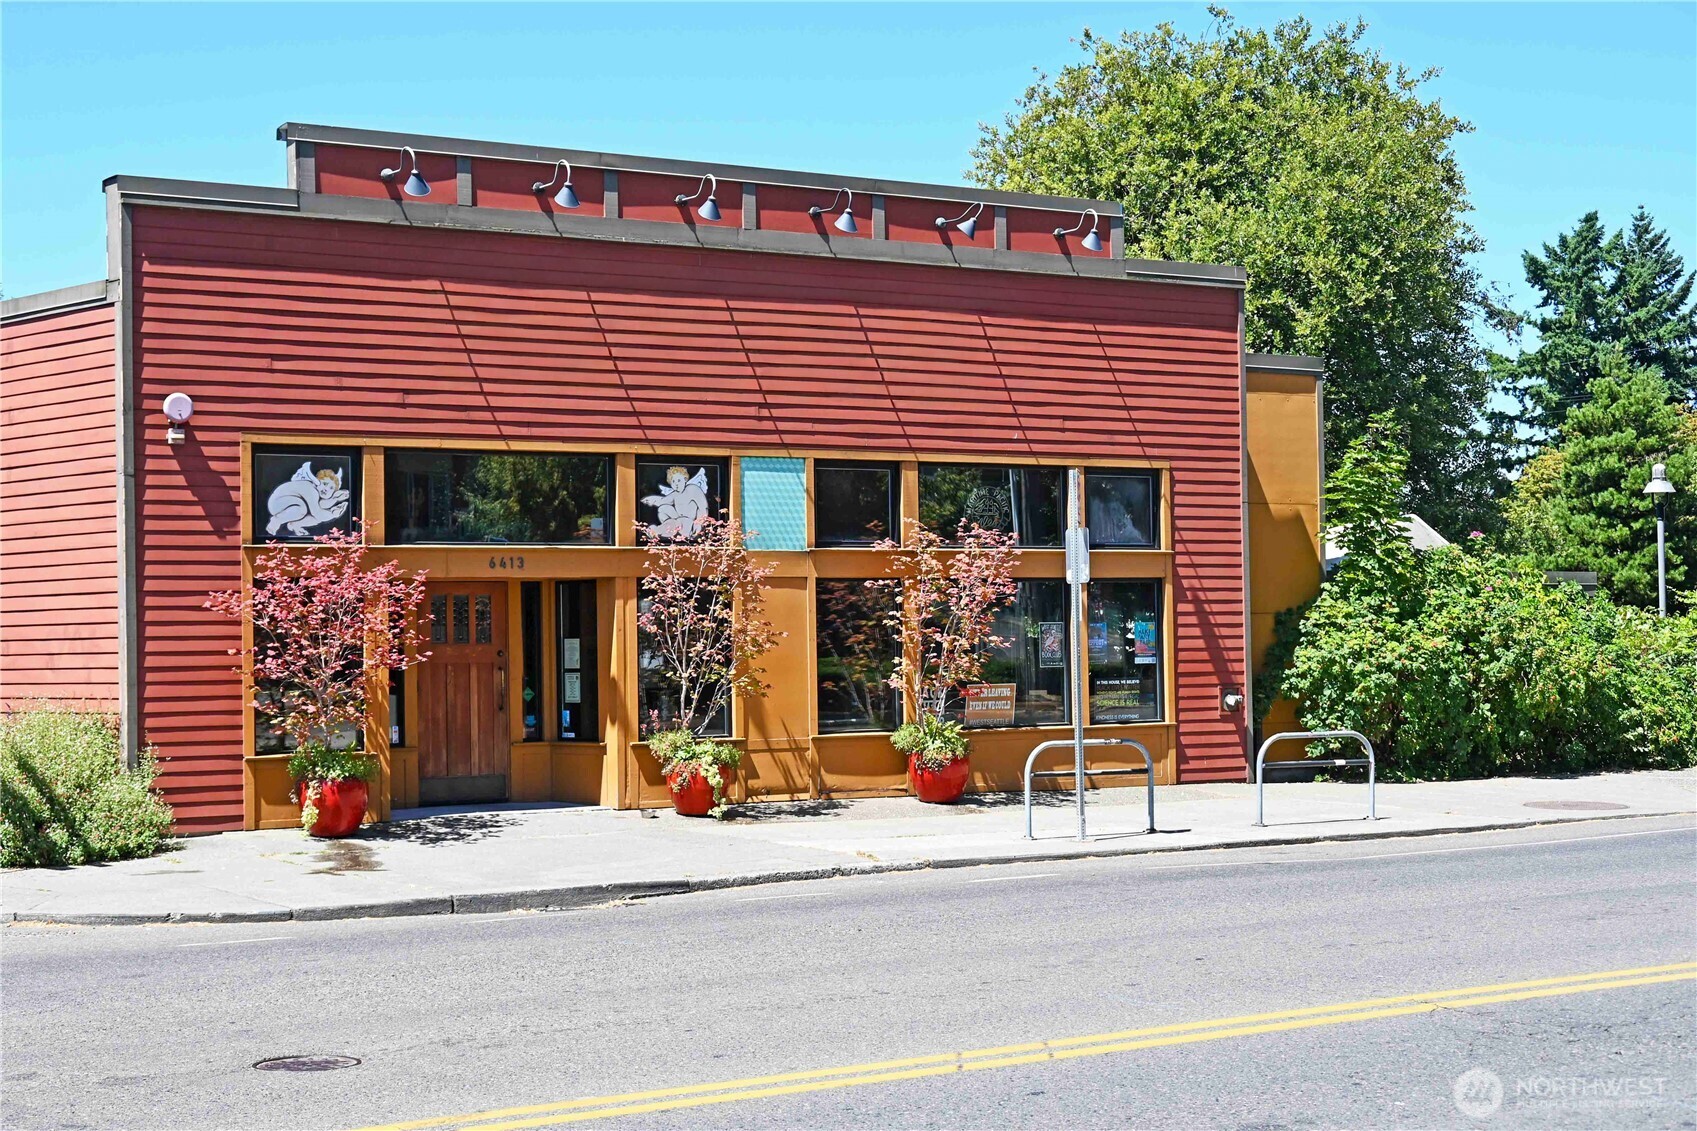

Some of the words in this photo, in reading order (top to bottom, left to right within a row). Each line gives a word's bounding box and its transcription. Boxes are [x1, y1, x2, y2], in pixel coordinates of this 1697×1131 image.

[488, 556, 525, 569] 6413
[988, 687, 1011, 697] LEAVING
[969, 702, 982, 710] EVEN
